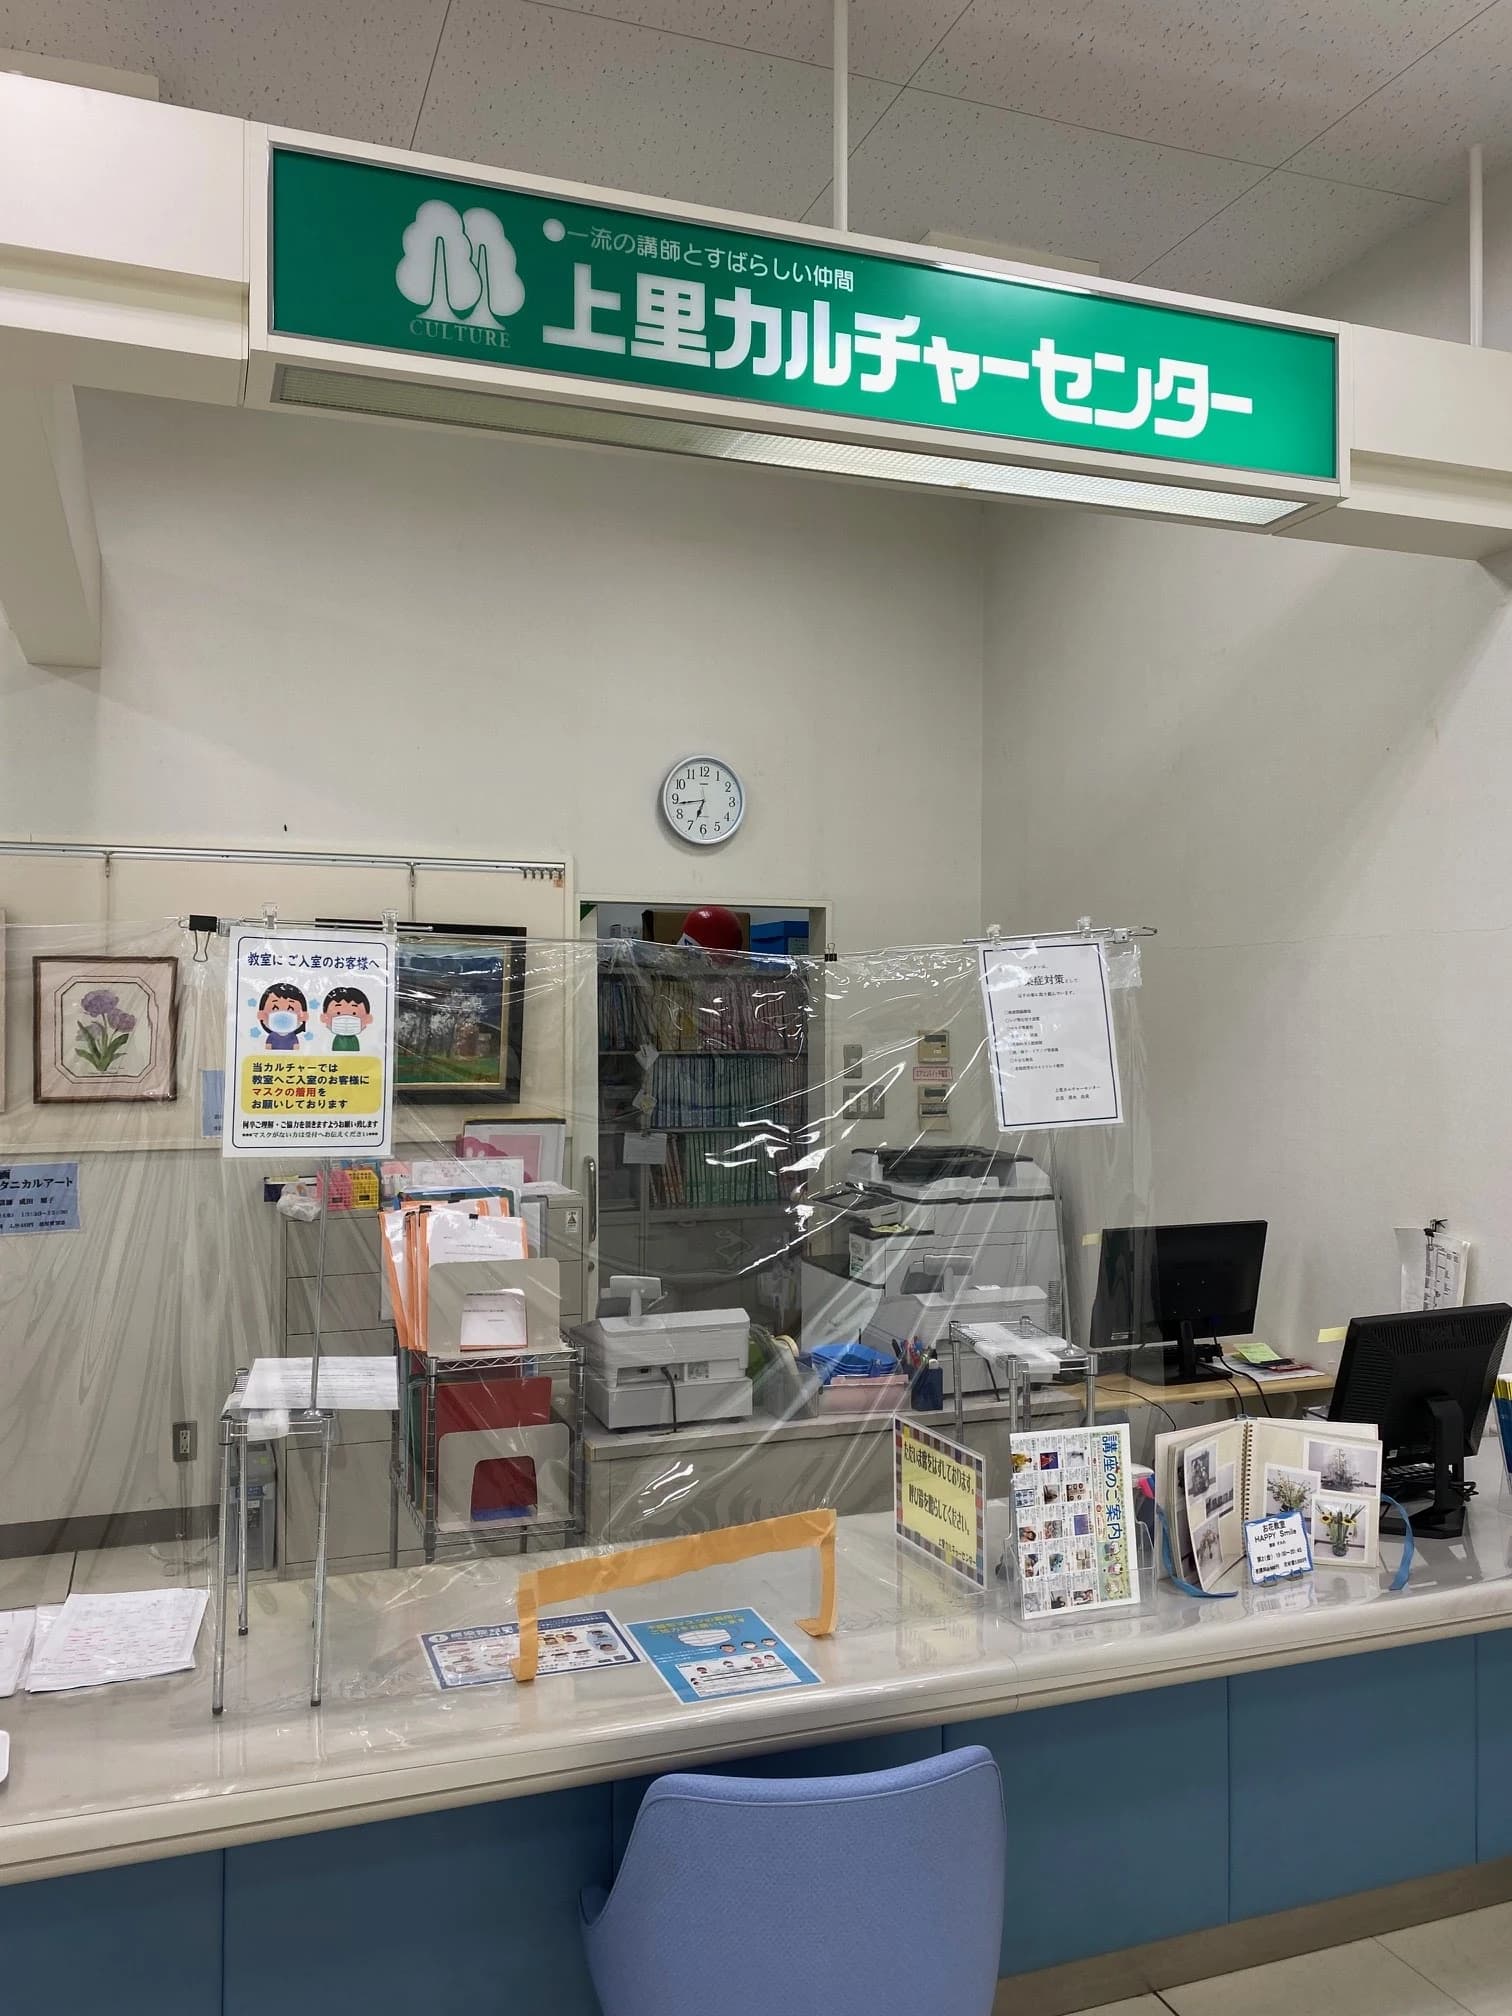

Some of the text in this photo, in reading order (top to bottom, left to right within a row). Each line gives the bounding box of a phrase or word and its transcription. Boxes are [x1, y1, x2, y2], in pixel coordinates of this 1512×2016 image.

[567, 226, 854, 292] 一流の講師とすばらしい仲間
[409, 319, 511, 348] CULTURE
[543, 262, 1253, 438] 上里カルチャーセンター
[687, 769, 695, 780] 11
[699, 766, 710, 777] 12
[716, 770, 720, 781] 1
[676, 779, 686, 790] 10
[725, 781, 731, 792] 2
[671, 793, 679, 805] 9
[728, 796, 736, 807] 3
[676, 809, 683, 819] 8
[724, 811, 730, 822] 4
[687, 820, 694, 830] 7
[699, 824, 707, 835] 6
[714, 822, 721, 832] 5
[248, 952, 380, 970] 教室に ご入室のお客様へ
[252, 1062, 338, 1073] 当カルチャーでは
[252, 1075, 370, 1086] 教室へご入室のお客様に
[252, 1087, 326, 1098] マスクの着用を
[251, 1099, 349, 1110] お願いしております
[904, 1440, 975, 1495] ただいま席をはずしております。
[1101, 1435, 1123, 1540] 講座のご案内
[1255, 1529, 1296, 1543] HAPPY Smile
